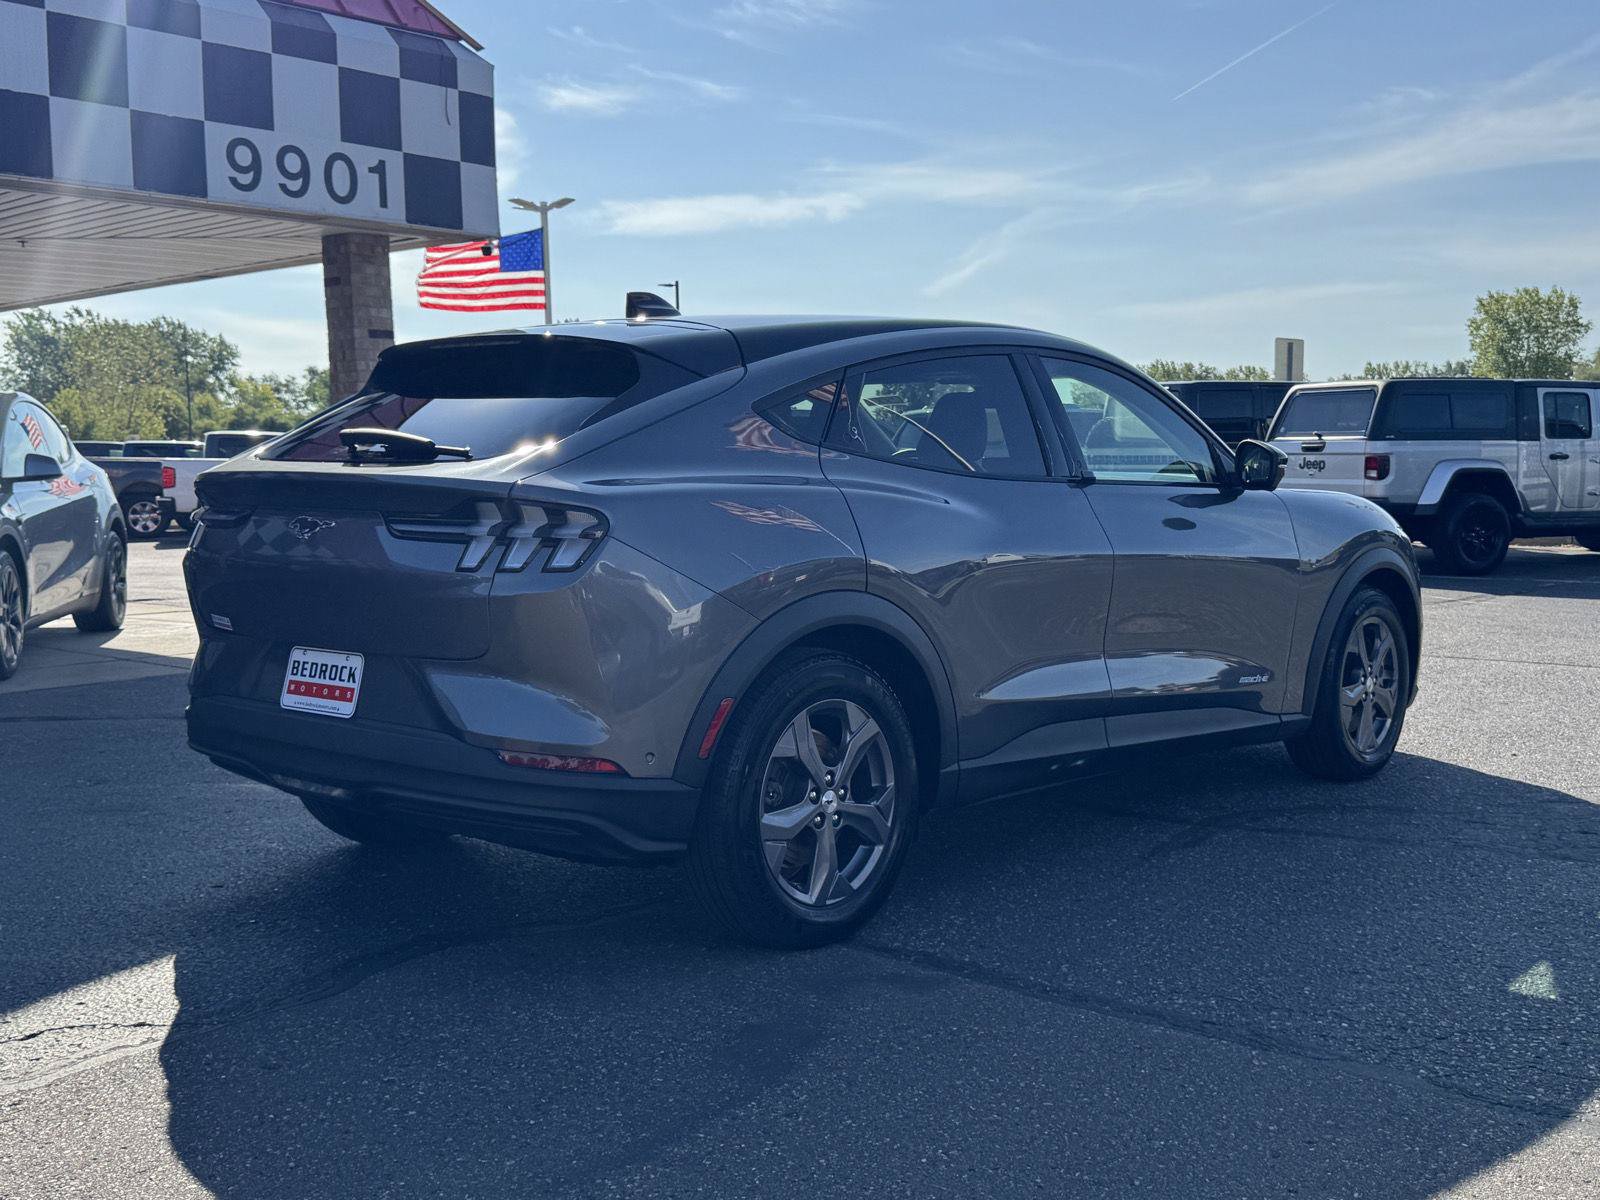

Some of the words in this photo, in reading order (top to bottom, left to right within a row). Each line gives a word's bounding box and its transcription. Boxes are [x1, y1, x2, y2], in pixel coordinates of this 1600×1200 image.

[226, 137, 388, 209] 9901
[1299, 457, 1326, 472] Jeep
[290, 660, 357, 684] BEDROCK
[289, 684, 352, 698] MOTORS
